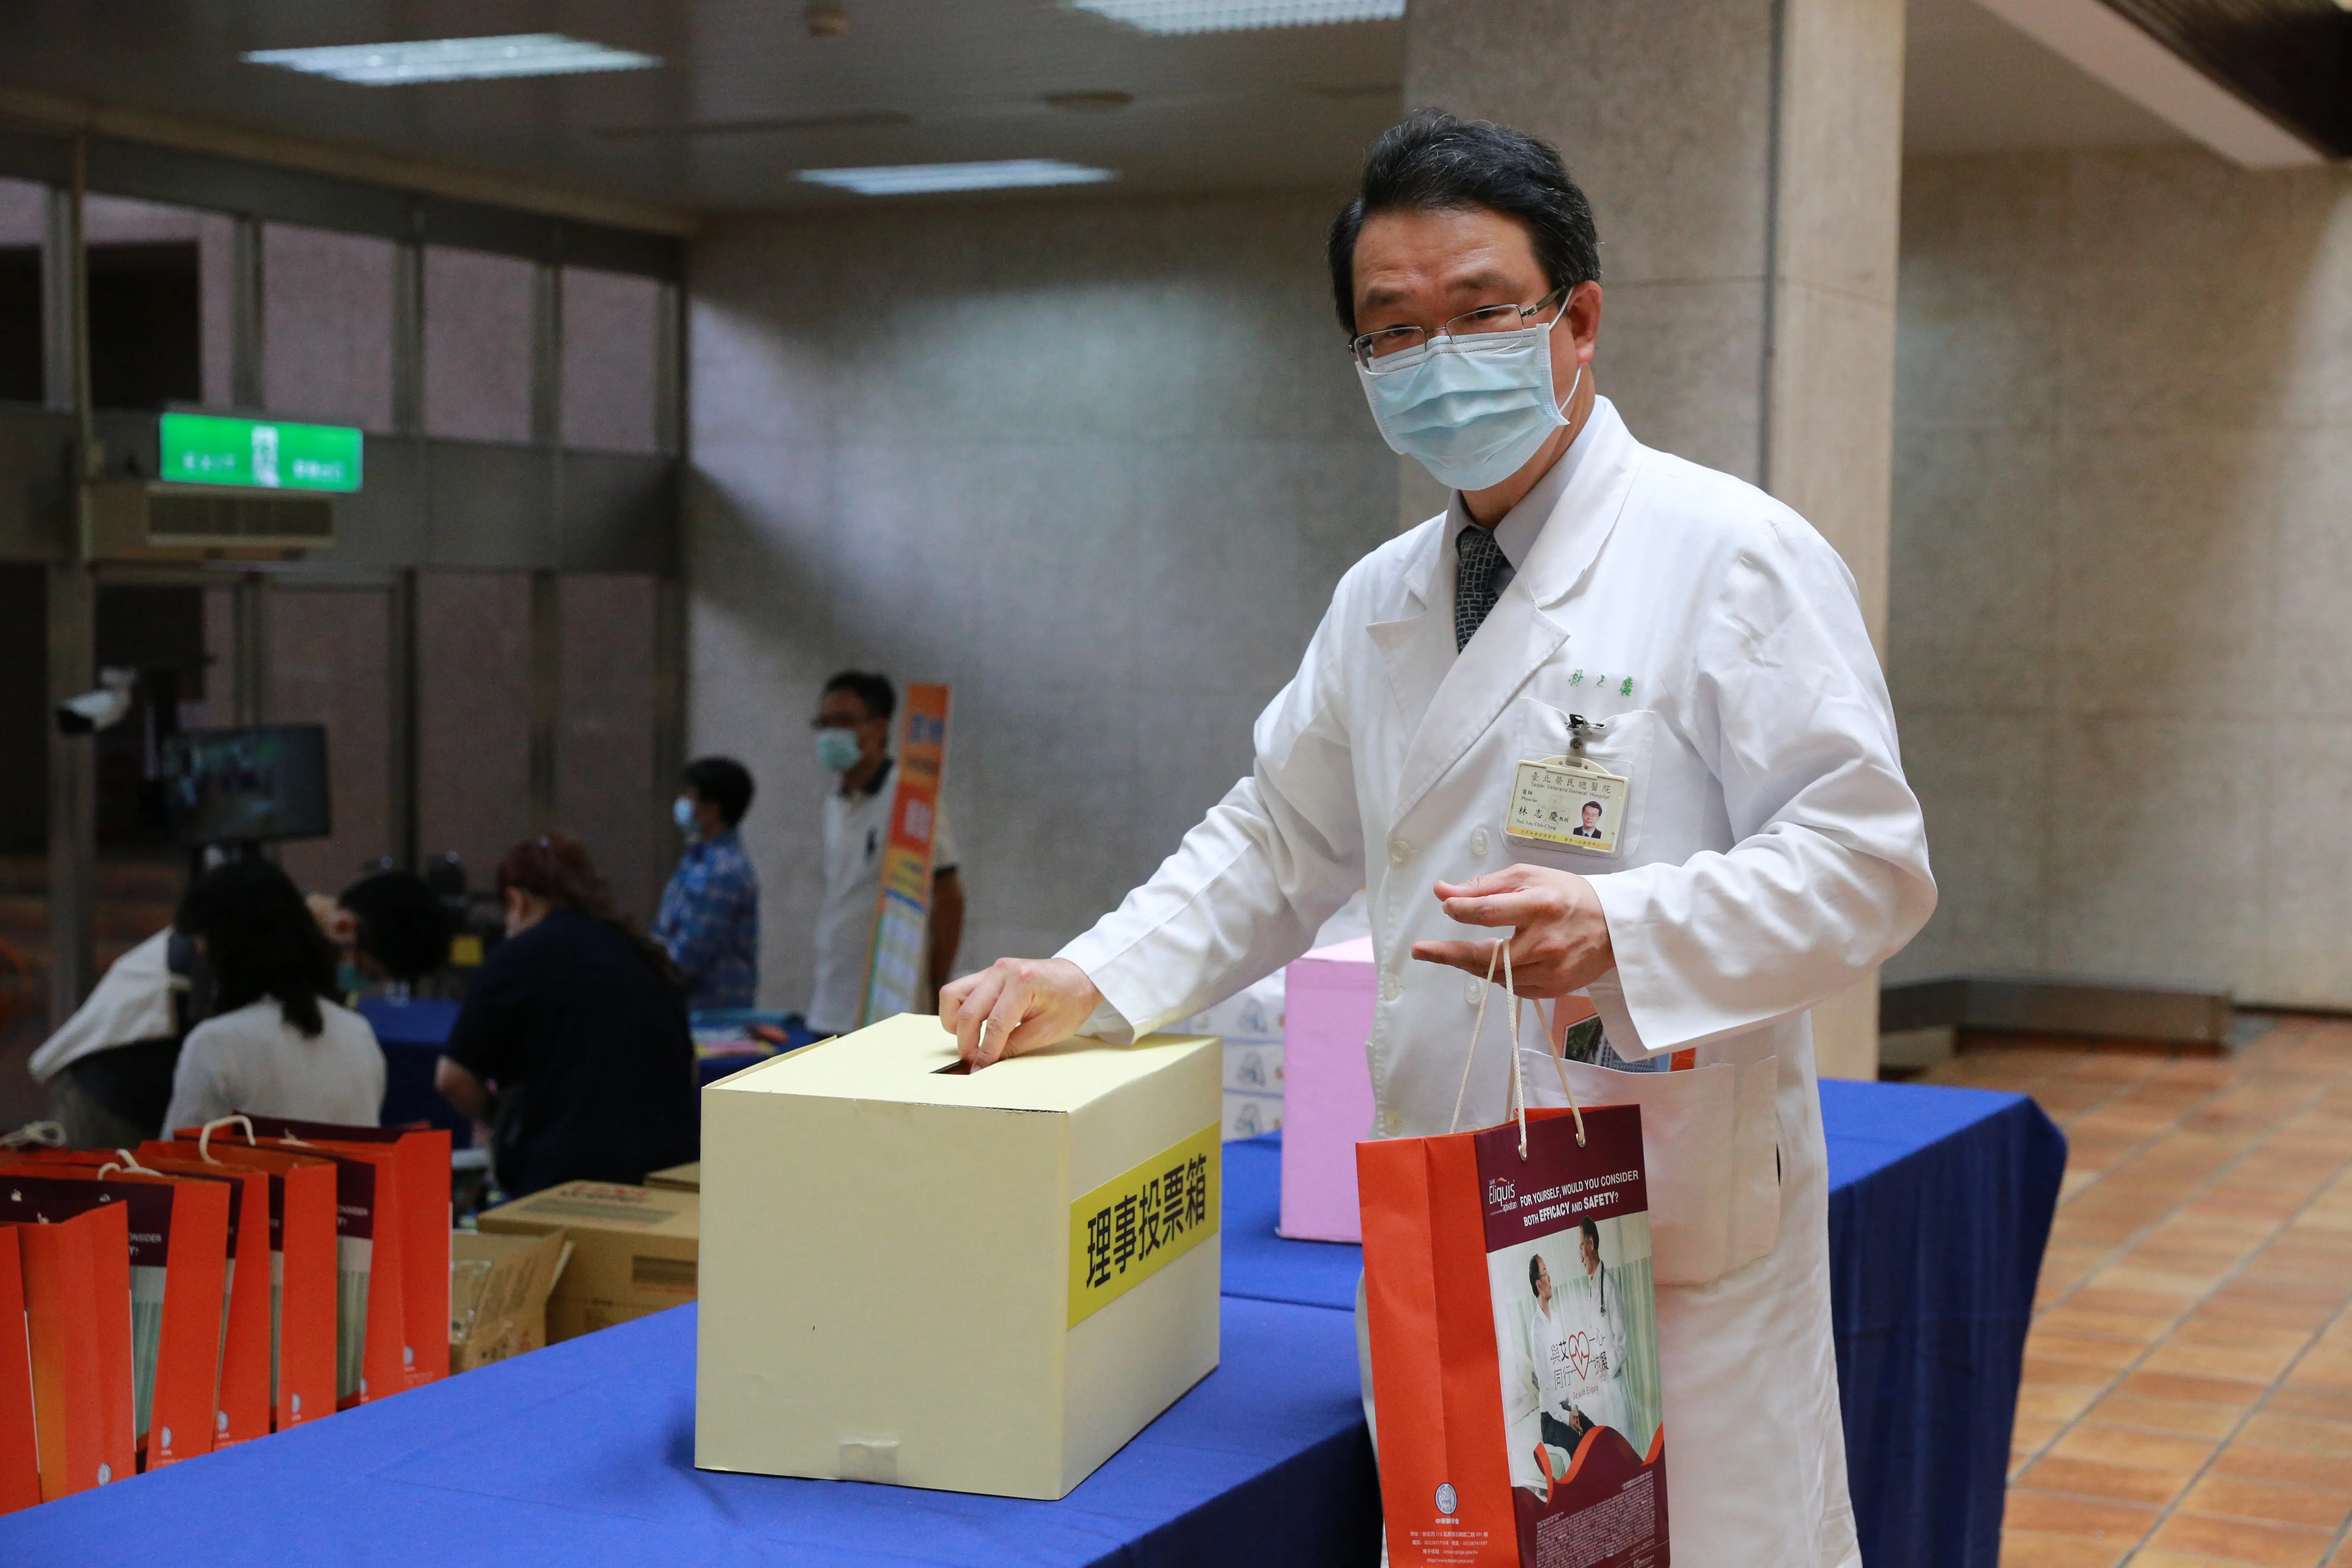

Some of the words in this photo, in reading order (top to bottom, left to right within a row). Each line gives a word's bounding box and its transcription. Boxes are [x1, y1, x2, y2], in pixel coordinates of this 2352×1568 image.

[1531, 772, 1611, 793] 臺北榮民總醫院
[1518, 806, 1558, 822] 林志慶
[1489, 1181, 1515, 1207] Eliquis
[1520, 1194, 1532, 1207] FOR
[1532, 1186, 1562, 1204] YOURSELF,
[1562, 1181, 1583, 1195] WOULD
[1584, 1177, 1599, 1190] YOU
[1601, 1170, 1638, 1186] CONSIDER
[1502, 1200, 1518, 1213] apixaban
[1523, 1213, 1539, 1226] BOTH
[1539, 1202, 1570, 1222] EFFICACY
[1571, 1201, 1583, 1213] AND
[1583, 1191, 1619, 1210] SAFETY?
[1086, 1153, 1207, 1289] 理事投票箱
[1550, 1340, 1569, 1365] 與艾
[1589, 1327, 1605, 1346] 一心
[1554, 1366, 1575, 1390] 同行
[1573, 1392, 1578, 1400] Go
[1586, 1385, 1599, 1395] Eliquis
